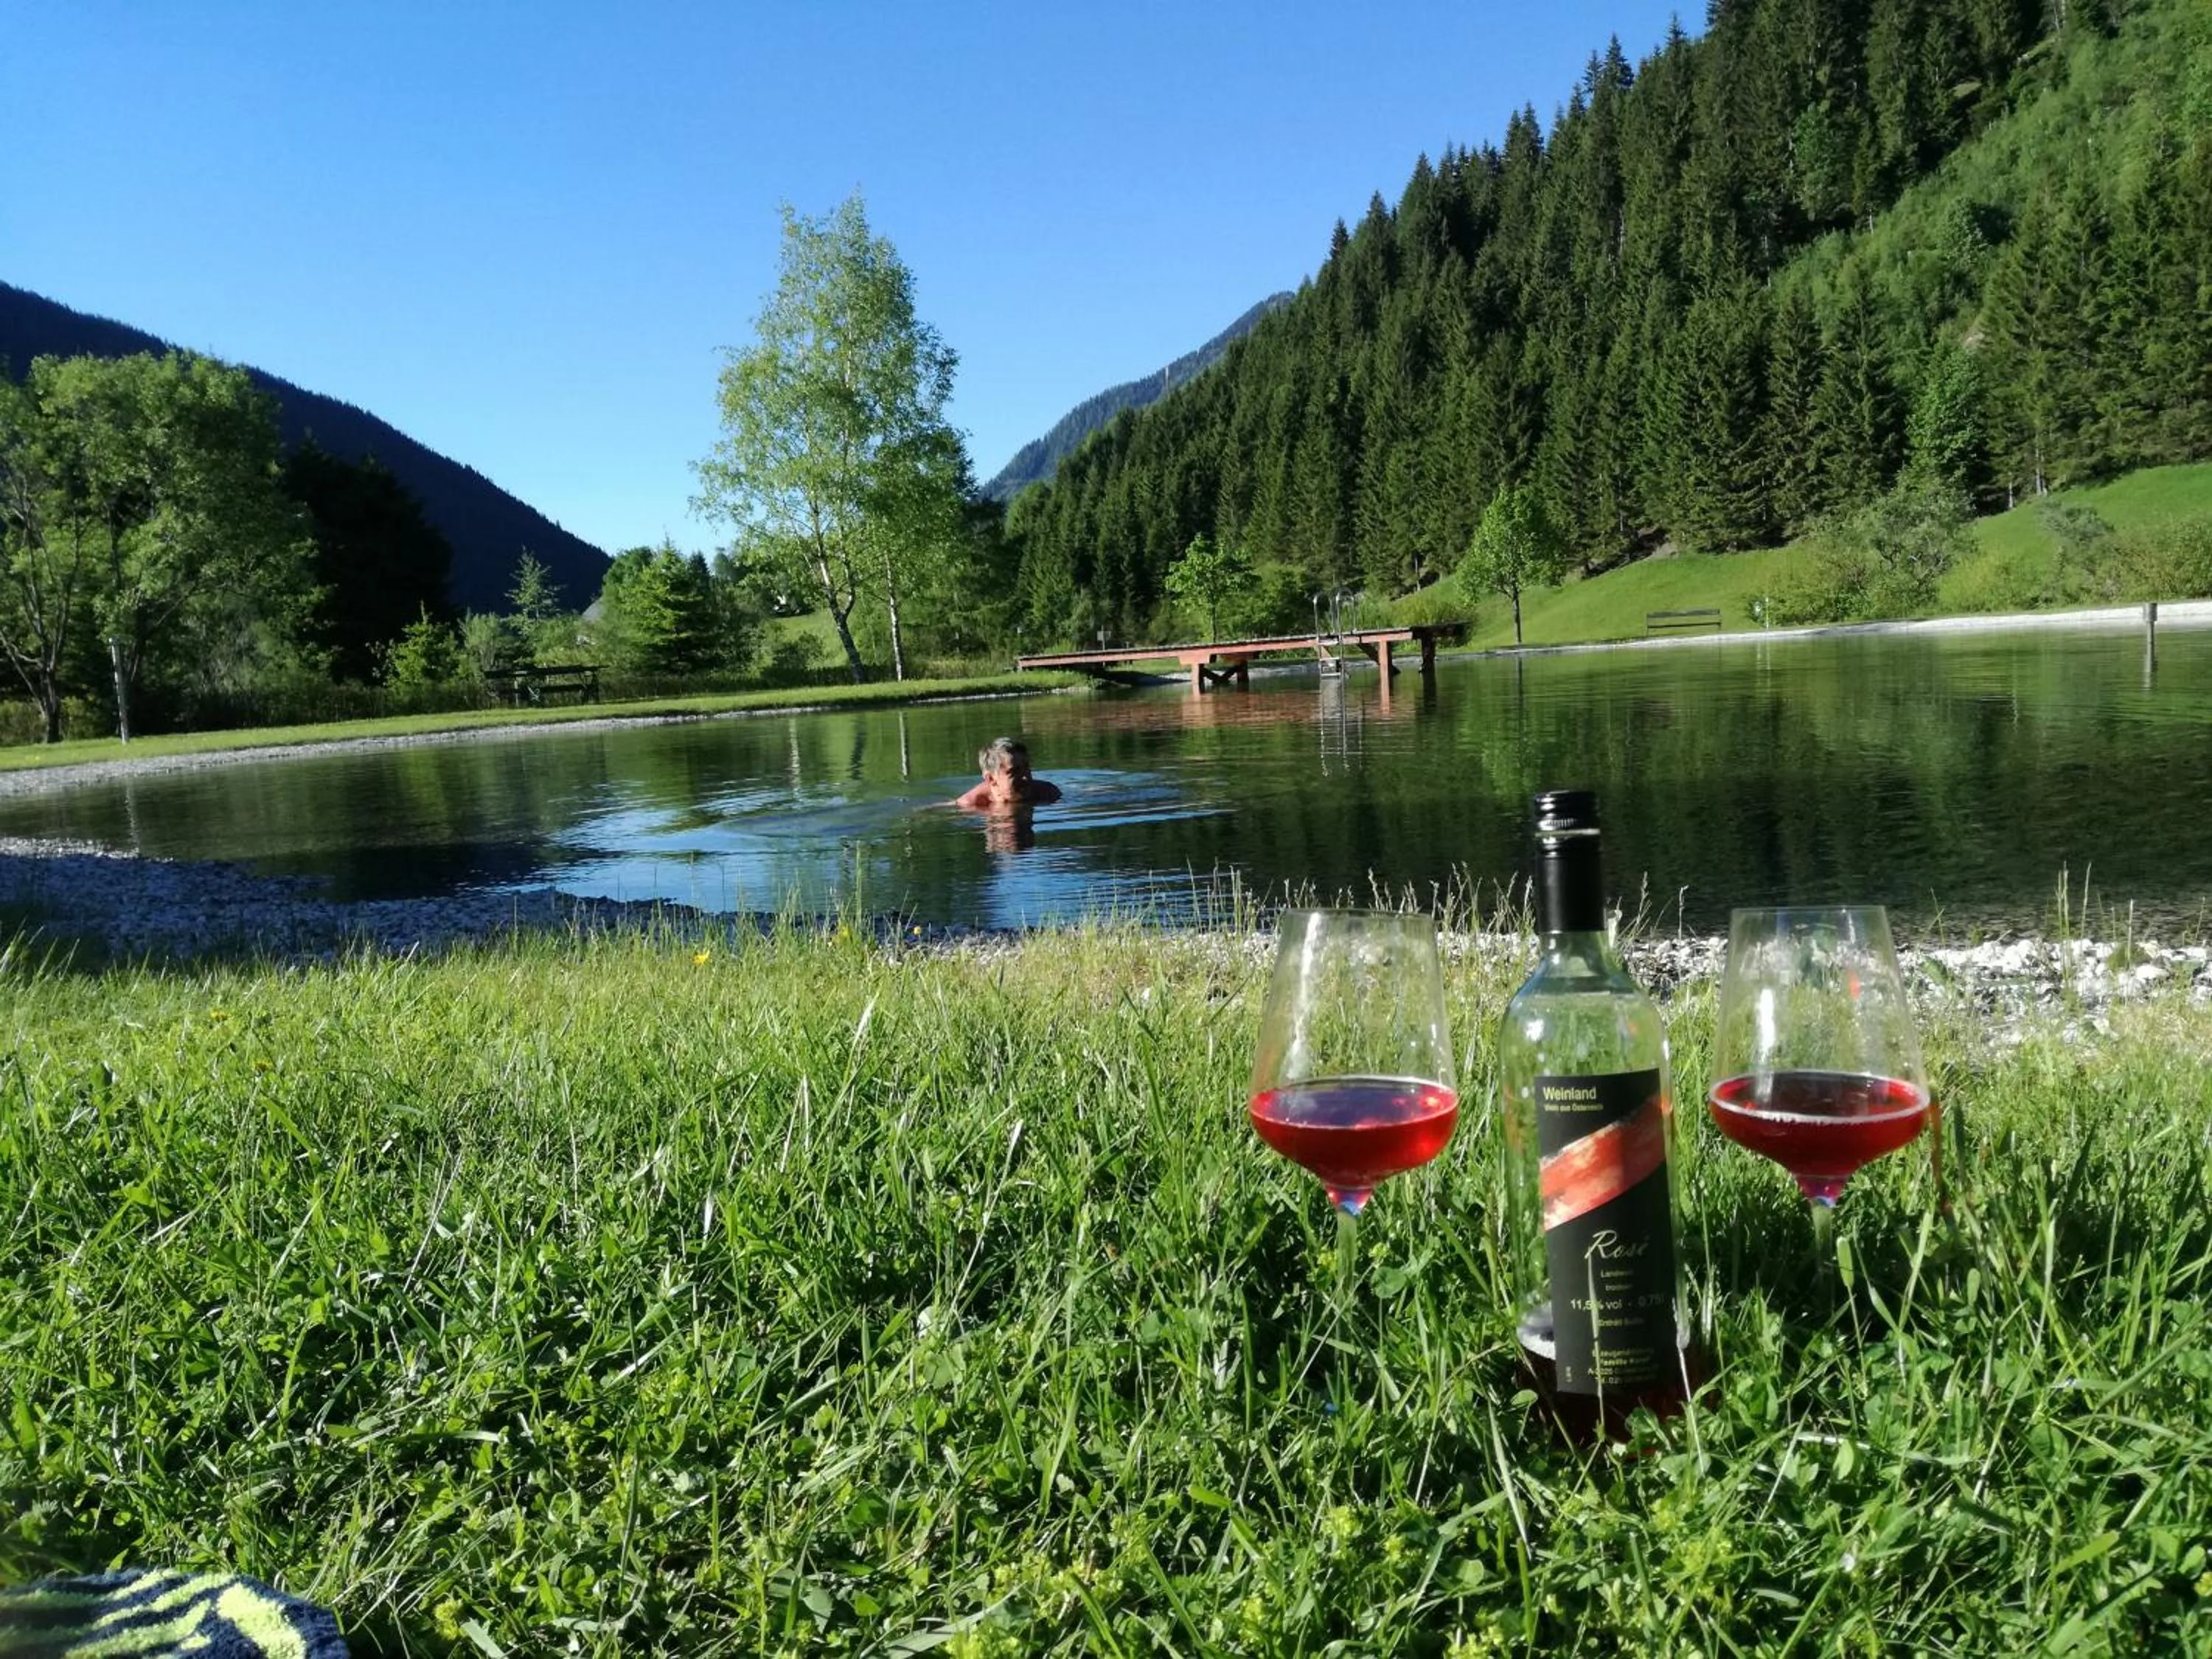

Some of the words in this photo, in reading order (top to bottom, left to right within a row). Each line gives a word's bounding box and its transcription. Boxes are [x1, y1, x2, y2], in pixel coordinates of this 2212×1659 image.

[1543, 1086, 1596, 1101] Weinland
[1584, 1229, 1649, 1259] Rosé
[1604, 1298, 1623, 1310] vol
